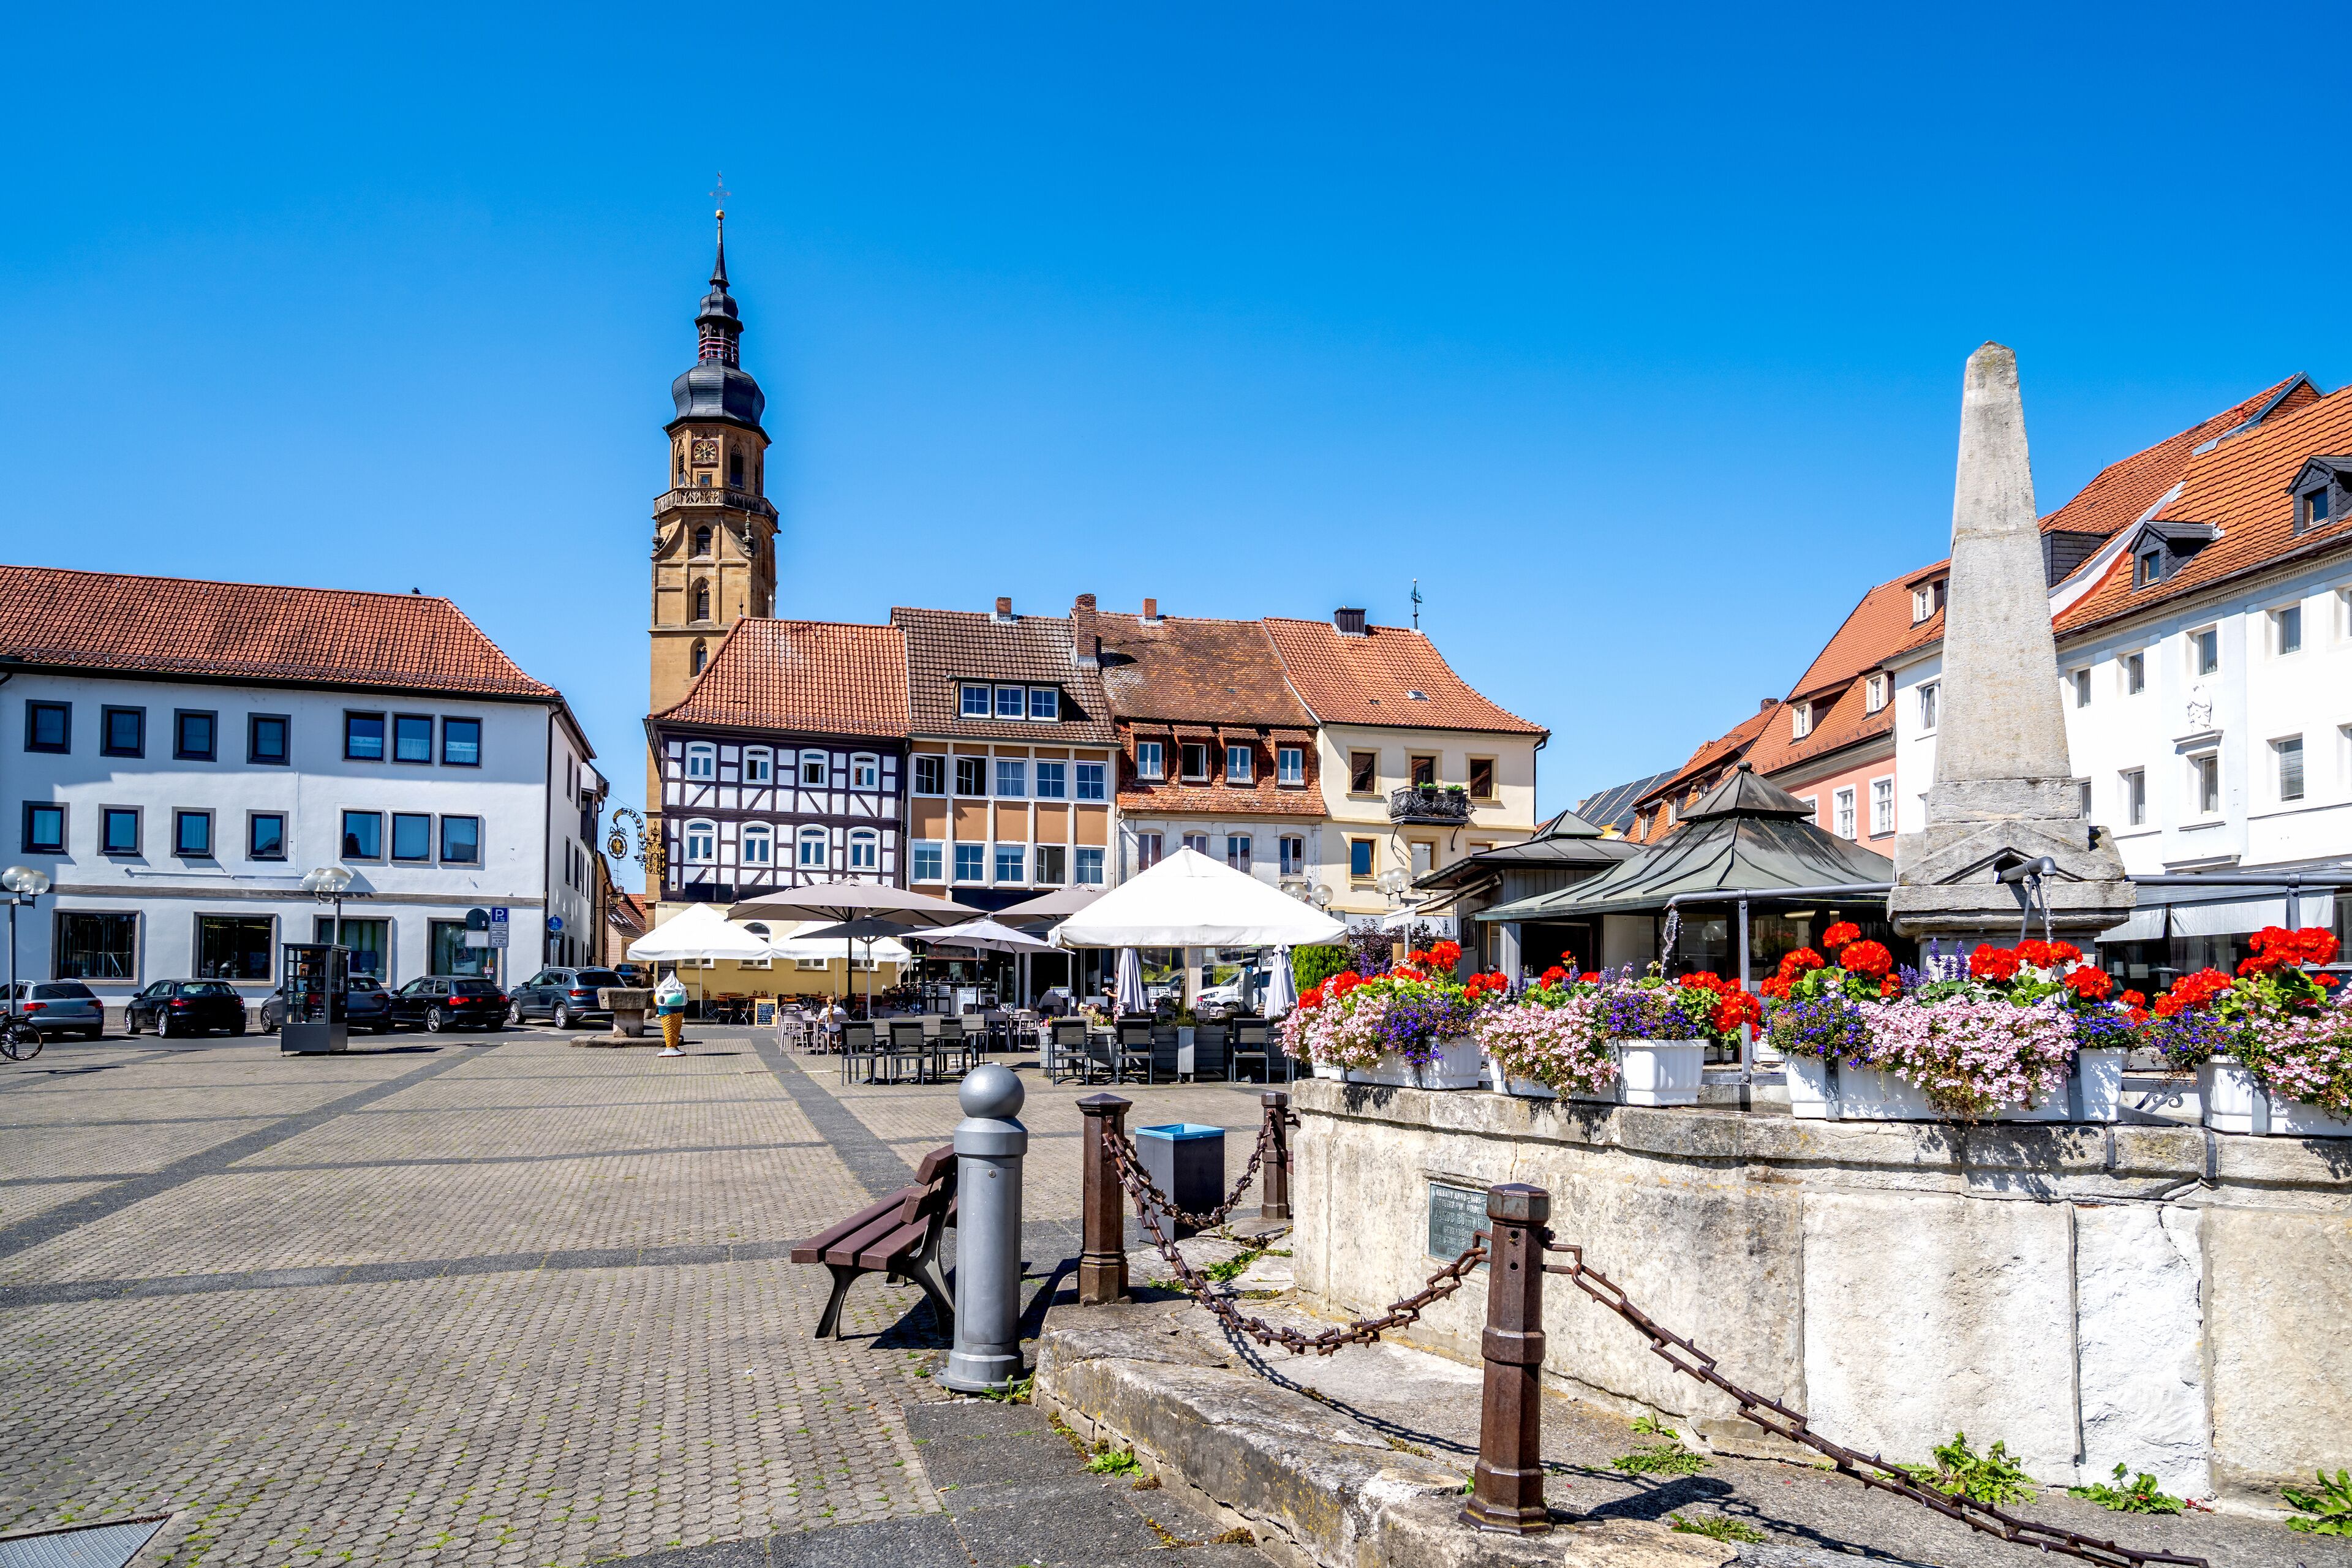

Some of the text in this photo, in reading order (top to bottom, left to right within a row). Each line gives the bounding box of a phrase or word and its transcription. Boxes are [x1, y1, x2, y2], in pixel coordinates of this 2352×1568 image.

[496, 909, 504, 921] P
[1454, 1192, 1466, 1202] ANNO
[1434, 1210, 1487, 1231] JAKOB BÜTTNER
